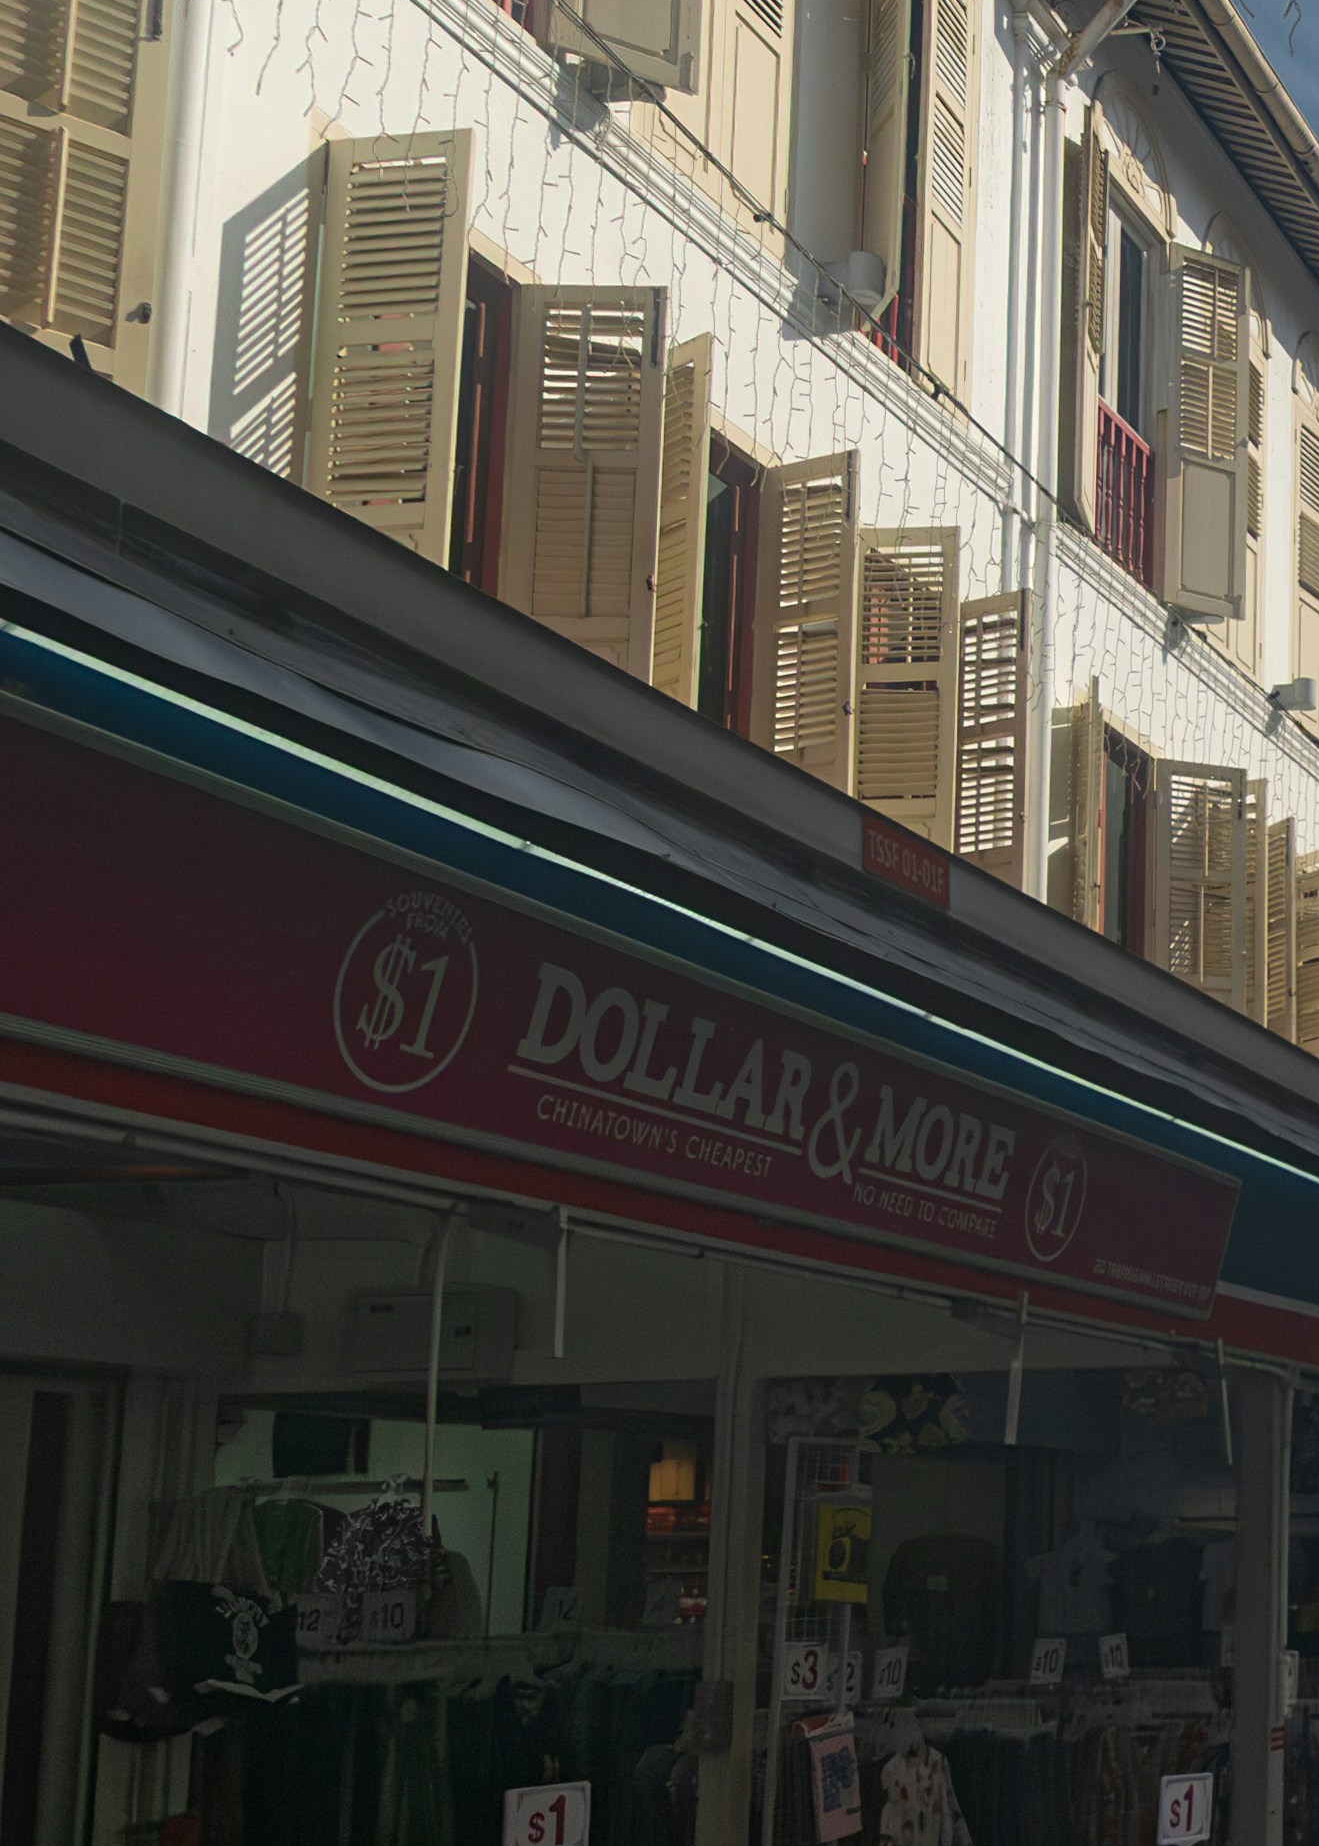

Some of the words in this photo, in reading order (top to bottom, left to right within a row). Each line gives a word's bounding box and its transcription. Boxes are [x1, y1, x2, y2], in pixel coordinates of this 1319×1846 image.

[868, 830, 900, 868] TSSF
[902, 849, 944, 893] 01-01F
[384, 892, 473, 945] SOUVENIRS
[406, 911, 449, 940] FROM
[355, 934, 449, 1059] $1
[537, 1094, 678, 1157] CHINATOWN'S
[685, 1131, 771, 1180] CHEAPEST
[853, 1178, 874, 1207] NO
[880, 1184, 913, 1217] NEED
[918, 1195, 936, 1223] TO
[939, 1200, 996, 1238] COMPARE
[1034, 1160, 1074, 1237] $1
[791, 1650, 818, 1690] $3
[1033, 1651, 1059, 1674] $10
[528, 1795, 566, 1845] $1
[1170, 1784, 1194, 1831] $1
